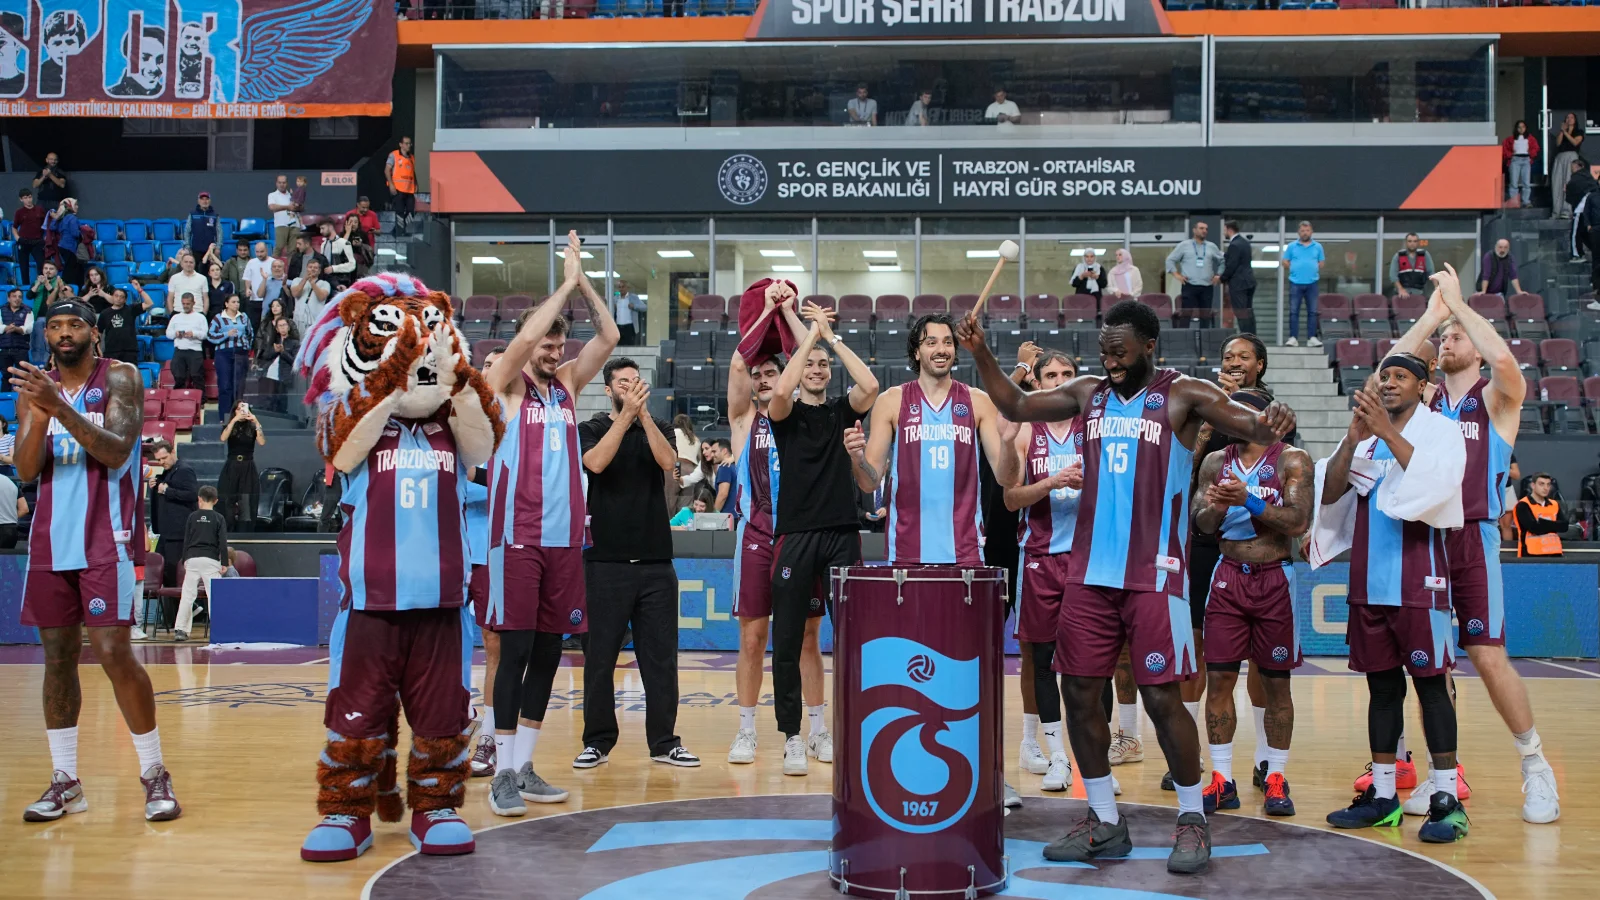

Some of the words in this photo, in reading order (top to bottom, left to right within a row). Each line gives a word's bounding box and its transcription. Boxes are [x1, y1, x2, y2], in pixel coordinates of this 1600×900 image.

[792, 0, 874, 24] SPOR
[985, 0, 1125, 22] TRABZON
[216, 103, 258, 117] ALPEREN
[778, 162, 811, 177] T.C.
[817, 158, 901, 180] GENÇLİK
[905, 161, 931, 176] VE
[953, 161, 1029, 174] TRABZON
[1043, 157, 1135, 174] ORTAHİSAR
[778, 182, 828, 197] SPOR
[832, 178, 930, 197] BAKANLIĞI
[953, 177, 1010, 197] HAYRİ
[1015, 177, 1057, 196] GÜR
[1062, 180, 1116, 196] SPOR
[1121, 180, 1202, 196] SALONU
[550, 428, 561, 451] 8
[904, 424, 972, 445] TRABZONSPOR
[1087, 417, 1162, 445] TRABZONSPOR
[60, 438, 79, 464] 17
[928, 446, 949, 469] 19
[1106, 442, 1128, 473] 15
[400, 478, 428, 508] 61
[902, 801, 939, 816] 1967
